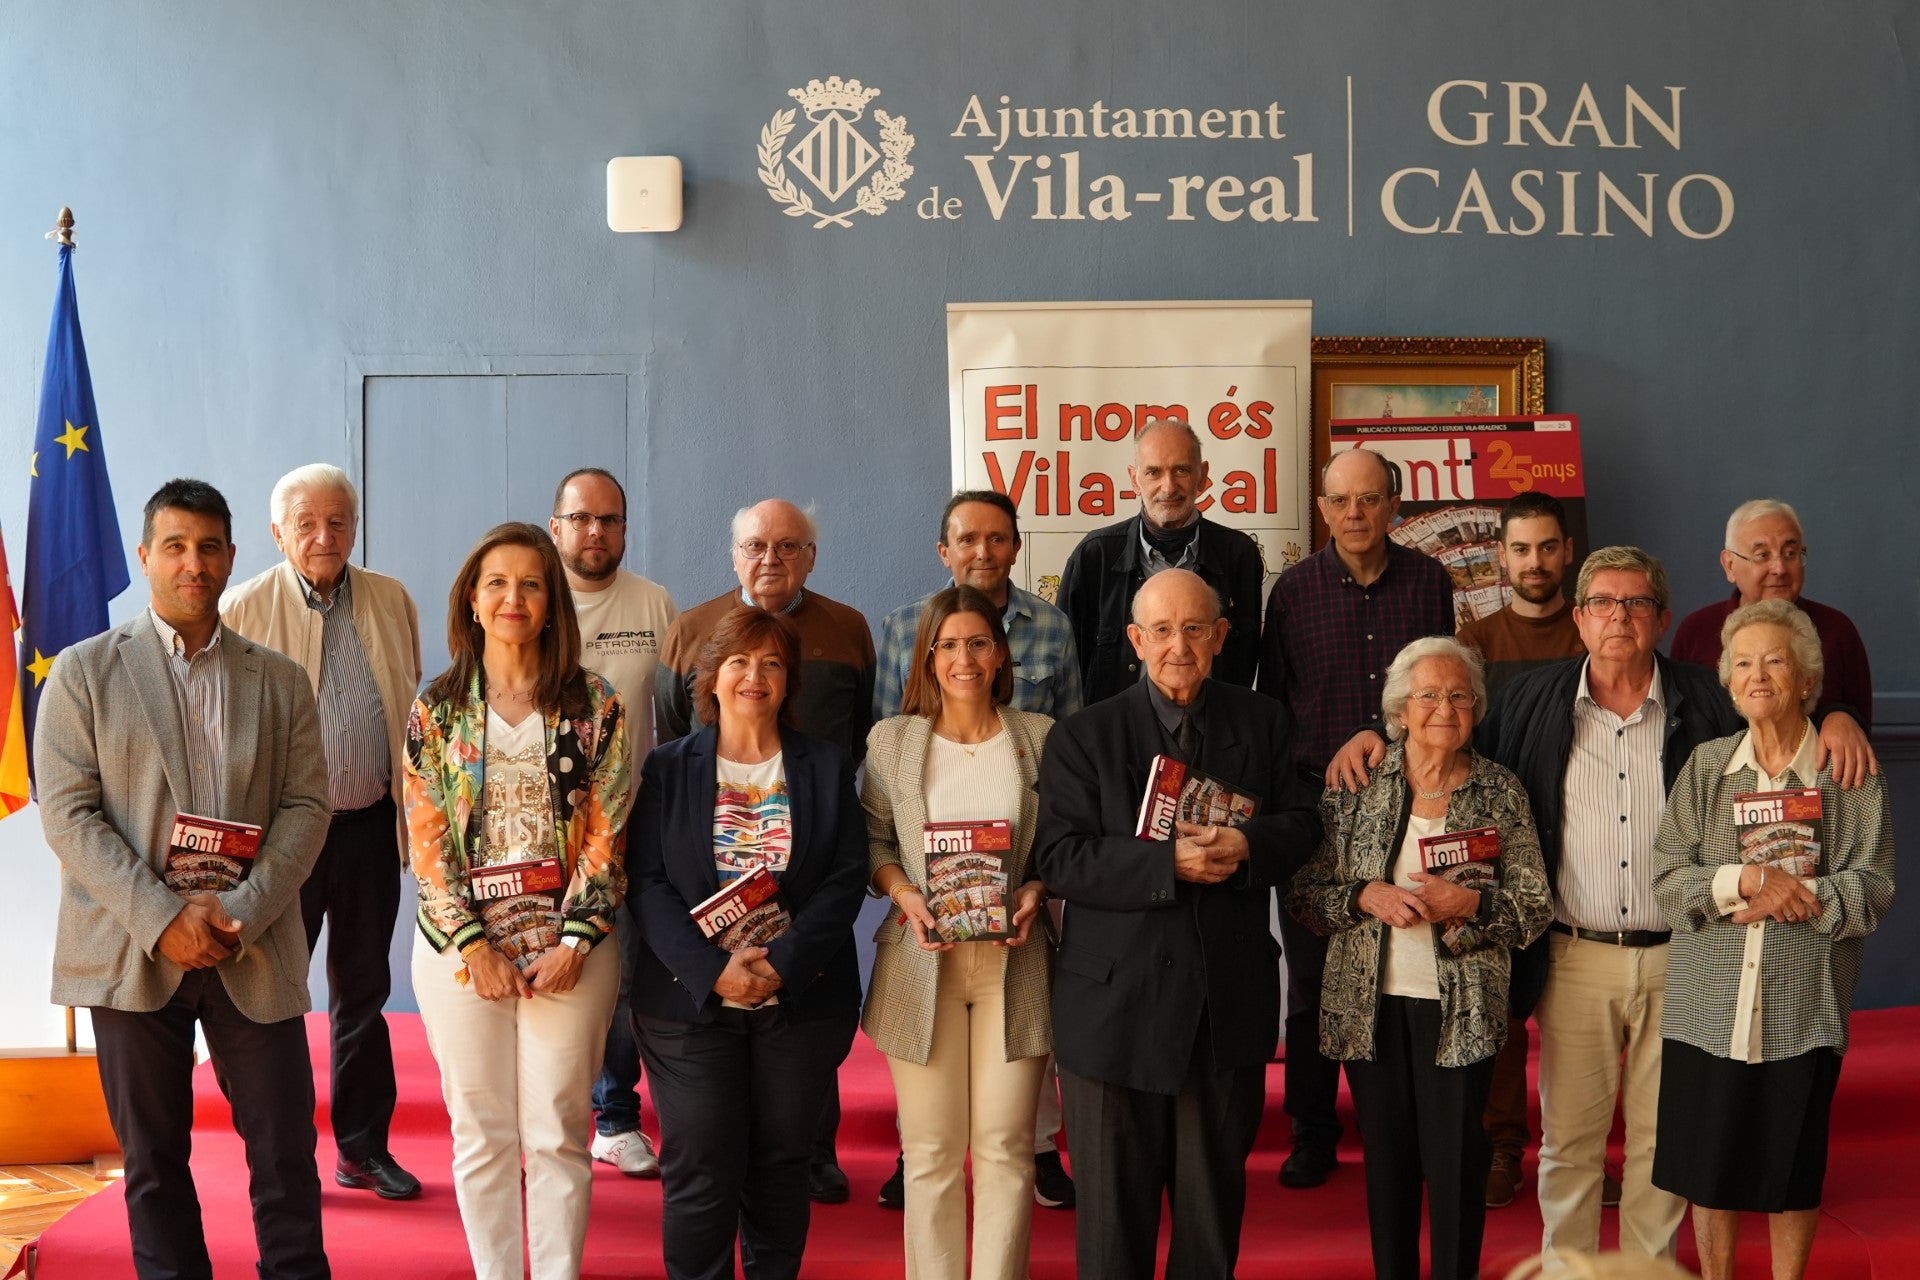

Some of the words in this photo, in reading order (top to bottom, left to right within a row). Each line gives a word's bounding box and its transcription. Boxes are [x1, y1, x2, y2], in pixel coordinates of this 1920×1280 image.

[951, 95, 1286, 151] Ajuntament
[1427, 80, 1686, 150] GRAN
[917, 187, 962, 220] de
[964, 150, 1319, 222] Vila-real
[1380, 167, 1734, 240] CASINO
[985, 385, 1037, 441] El
[1208, 386, 1274, 440] és
[982, 448, 1278, 516] Vila-al
[1531, 462, 1576, 483] anys
[586, 640, 657, 650] PETRONAS
[1151, 795, 1176, 837] font
[1740, 800, 1782, 825] font
[178, 825, 220, 854] font
[929, 829, 972, 853] font
[1430, 840, 1469, 868] font
[479, 872, 523, 899] font
[705, 898, 747, 934] font
